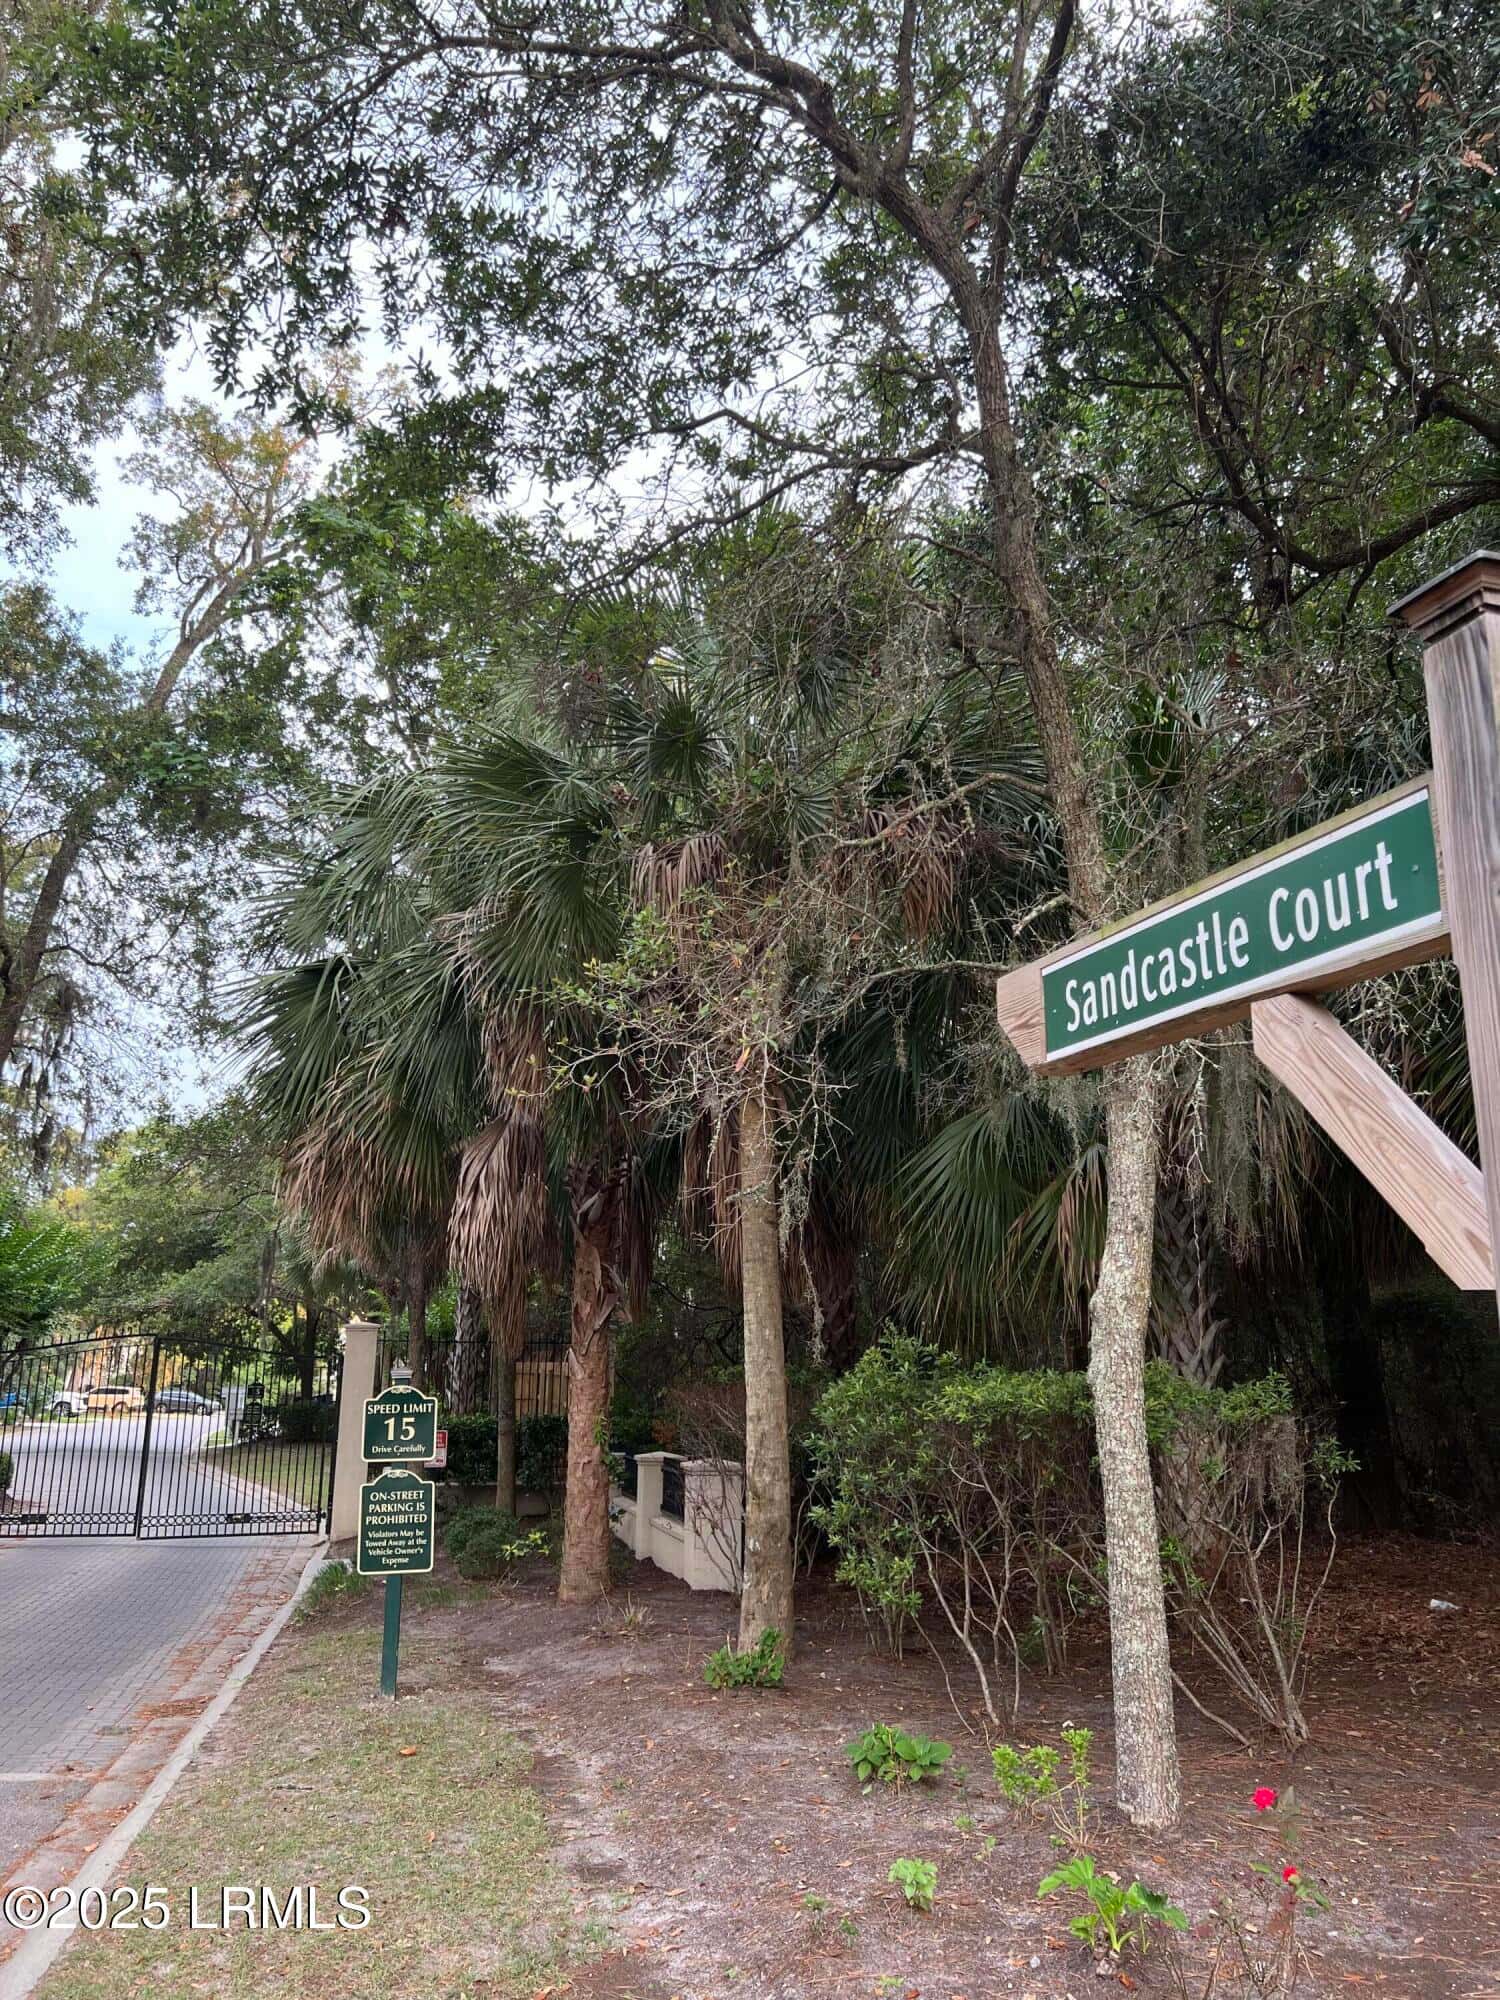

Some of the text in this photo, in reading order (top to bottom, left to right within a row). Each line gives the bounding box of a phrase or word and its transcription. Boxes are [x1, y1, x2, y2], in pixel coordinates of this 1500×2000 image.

[1065, 841, 1399, 1032] Sandcastle Court
[367, 1403, 433, 1414] SPEED LIMIT
[384, 1417, 416, 1441] 15
[371, 1444, 426, 1455] Drive Carefully
[370, 1491, 424, 1501] ON-STREET
[368, 1502, 425, 1513] PARKING IS
[366, 1514, 427, 1525] PROHIBITED
[368, 1528, 425, 1539] Violators May be
[365, 1537, 427, 1548] Towed Away at the
[368, 1547, 423, 1556] Vehicle Owner's
[382, 1556, 409, 1565] Expense
